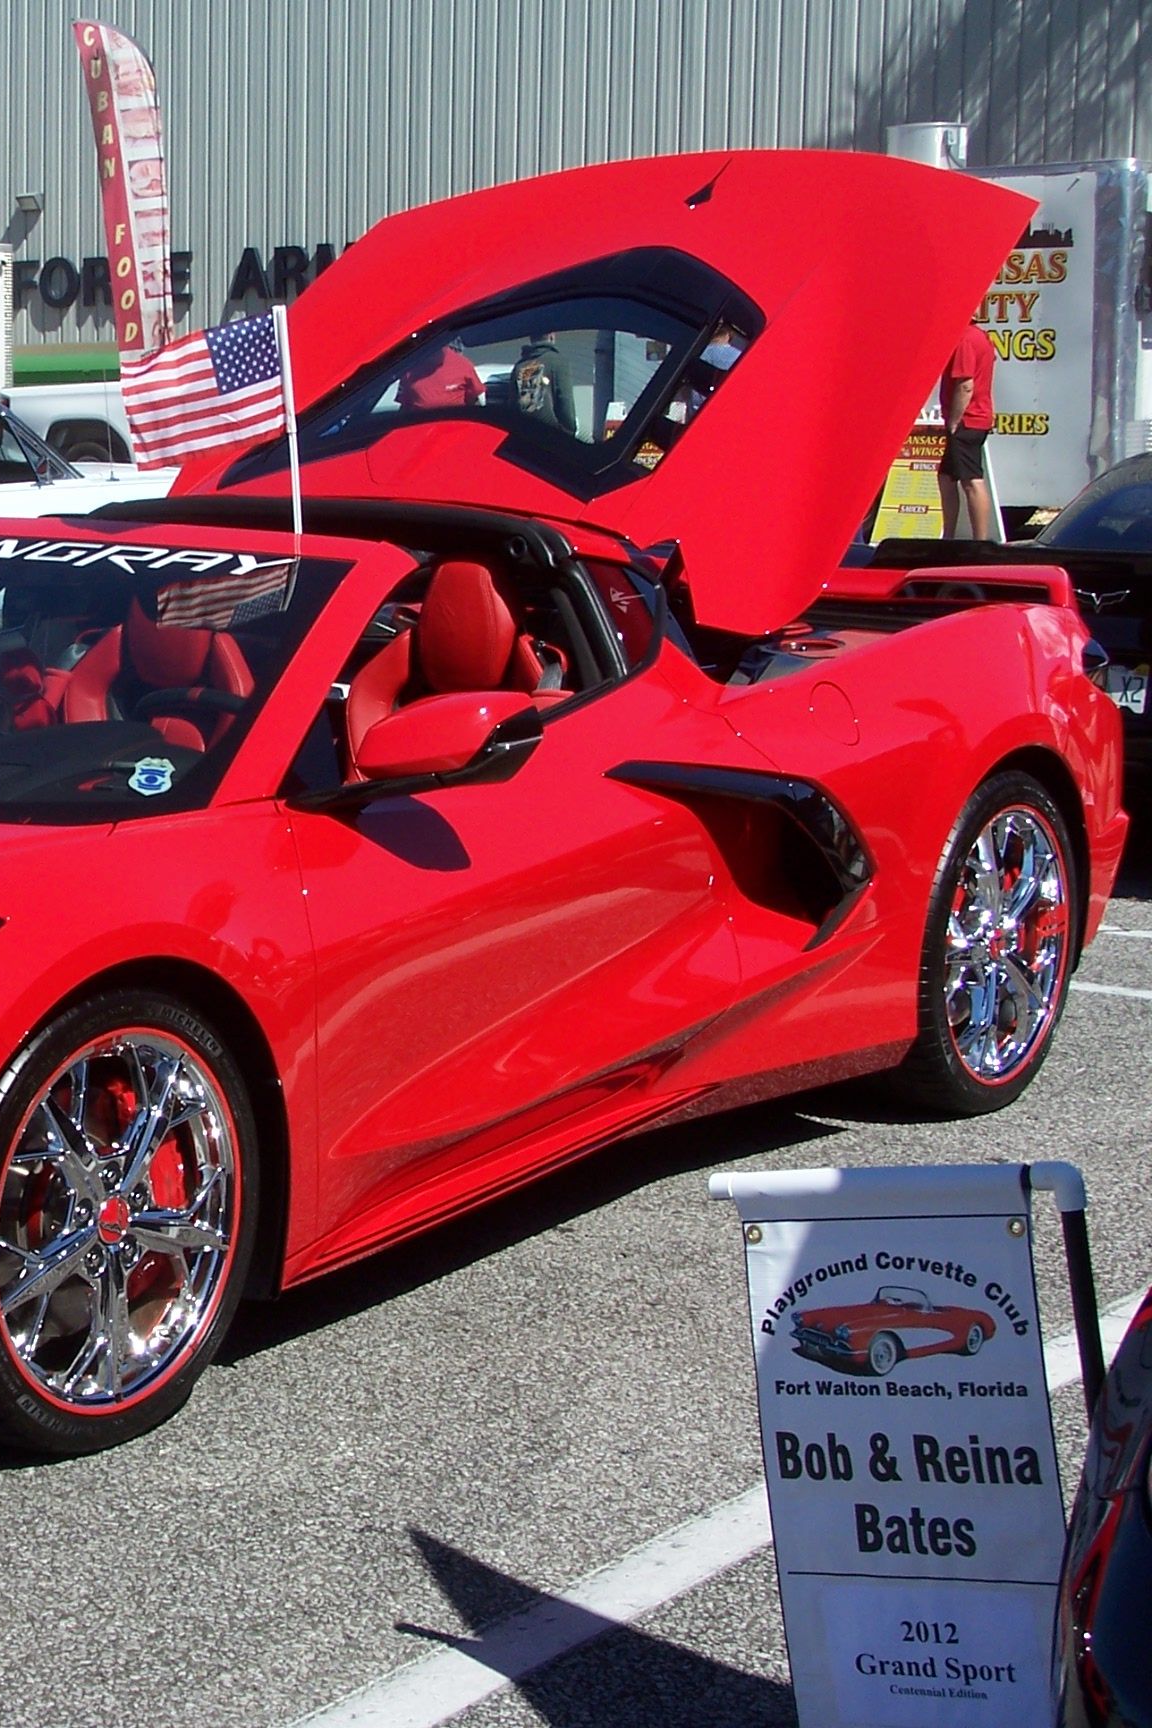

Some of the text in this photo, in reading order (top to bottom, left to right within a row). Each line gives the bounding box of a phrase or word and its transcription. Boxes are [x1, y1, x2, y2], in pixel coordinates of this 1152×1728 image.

[83, 26, 138, 343] CUBAN FOOD
[12, 250, 194, 309] FORE
[911, 447, 946, 457] WINGS
[761, 1251, 1030, 1337] Playground Corvette Club
[775, 1380, 1029, 1400] Fort Walton Beach, Florida
[775, 1431, 1044, 1485] Bob & Reina
[854, 1503, 977, 1558] Bates
[900, 1620, 960, 1645] 2012
[855, 1653, 1017, 1686] Grand Sport
[889, 1684, 989, 1700] Centennial Edition
